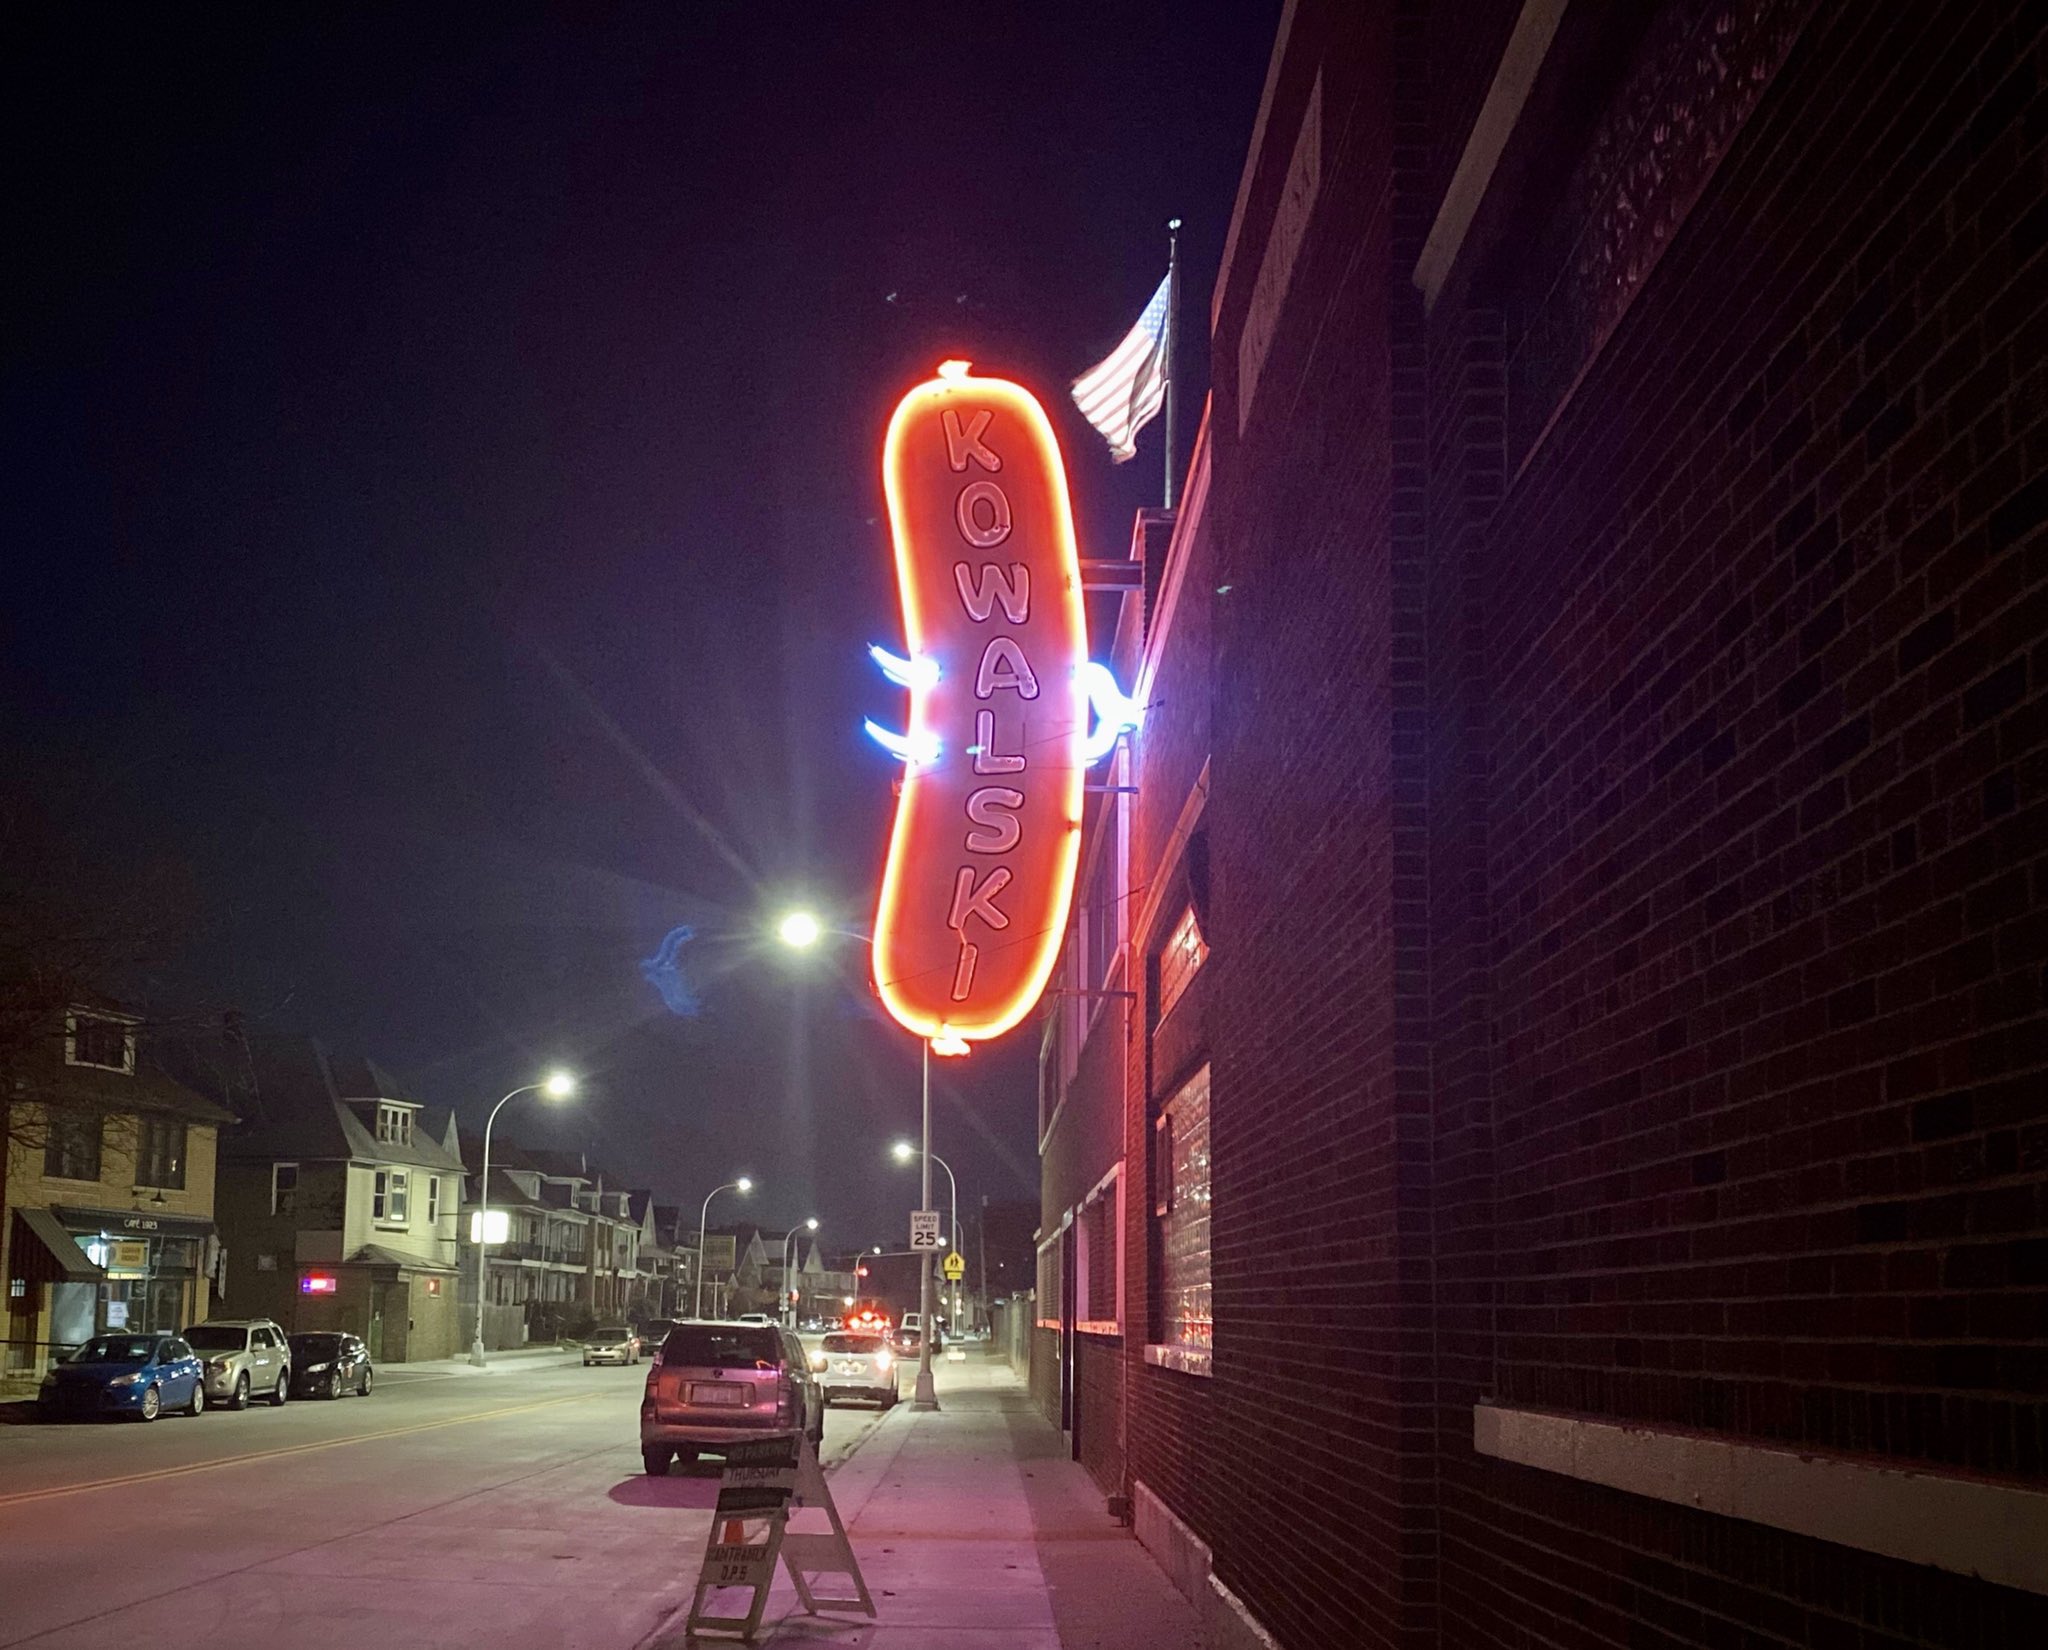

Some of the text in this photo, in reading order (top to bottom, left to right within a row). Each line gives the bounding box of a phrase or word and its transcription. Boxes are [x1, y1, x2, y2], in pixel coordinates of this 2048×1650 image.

[941, 409, 1040, 1001] KOWALSKI
[142, 1220, 158, 1230] 1923
[914, 1232, 936, 1246] 25
[745, 1442, 789, 1459] PARKING
[730, 1467, 780, 1481] THURSDAY
